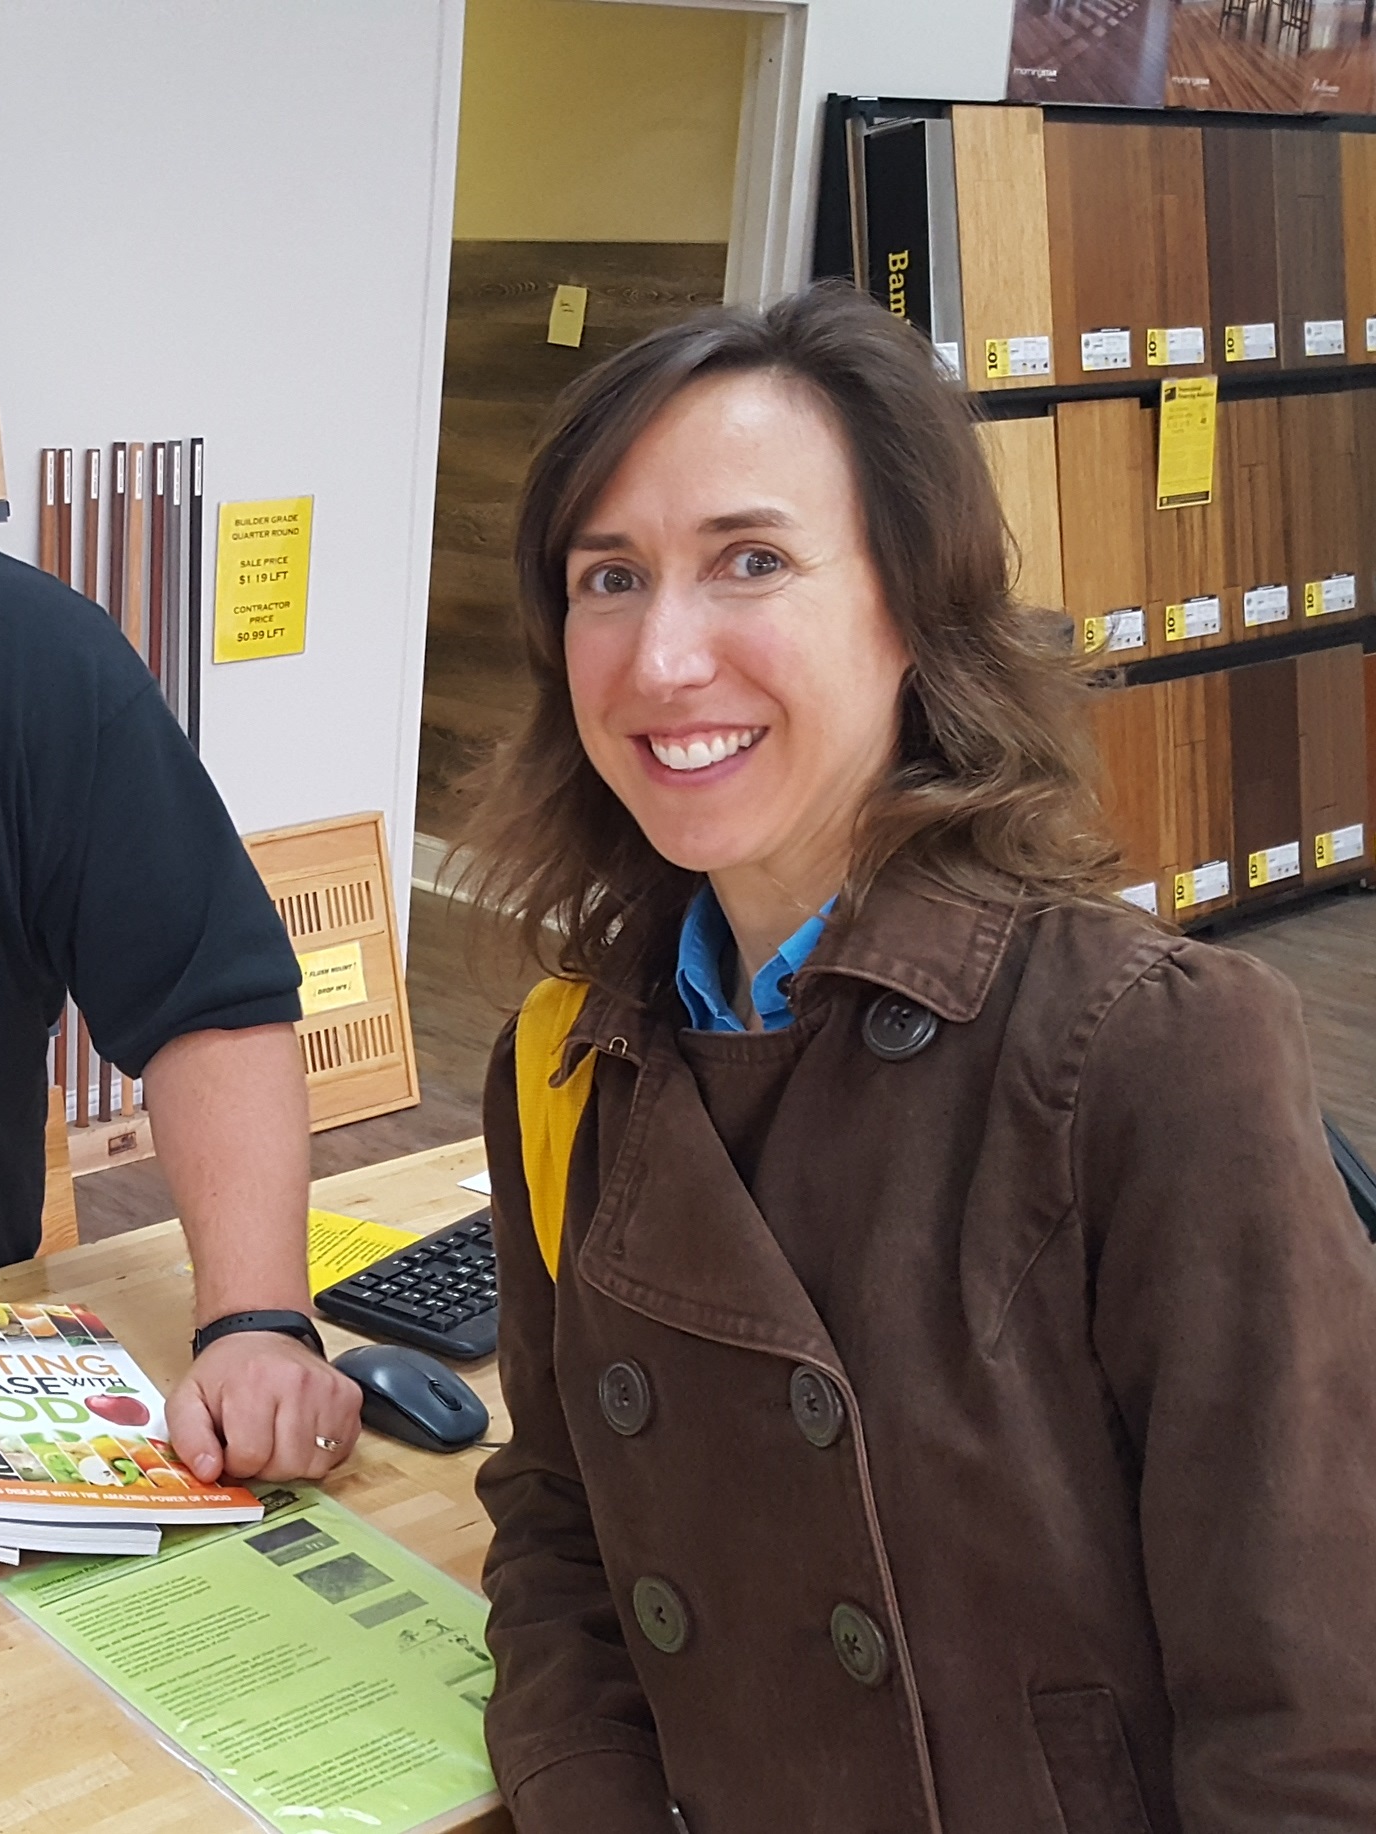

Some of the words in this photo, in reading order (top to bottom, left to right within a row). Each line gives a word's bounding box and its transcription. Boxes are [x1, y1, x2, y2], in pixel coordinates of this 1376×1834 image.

[888, 250, 911, 325] Bam
[234, 516, 269, 527] BUILDER
[271, 514, 299, 524] GRADE
[232, 530, 270, 540] QUARTER
[271, 527, 300, 537] ROUND
[240, 558, 262, 568] SALE
[263, 556, 288, 566] PRICE
[269, 571, 289, 582] LFT
[233, 601, 291, 614] CONTRACTOR
[249, 615, 274, 624] PRICE
[237, 630, 265, 642] $0.99
[266, 627, 285, 639] LFT
[61, 1377, 128, 1389] WITH
[5, 1487, 48, 1497] DISEASE
[50, 1489, 78, 1498] WITH
[80, 1490, 99, 1499] THE
[102, 1492, 149, 1502] AMAZING
[149, 1493, 187, 1503] POWER
[188, 1494, 202, 1503] OF
[204, 1494, 231, 1502] FOOD
